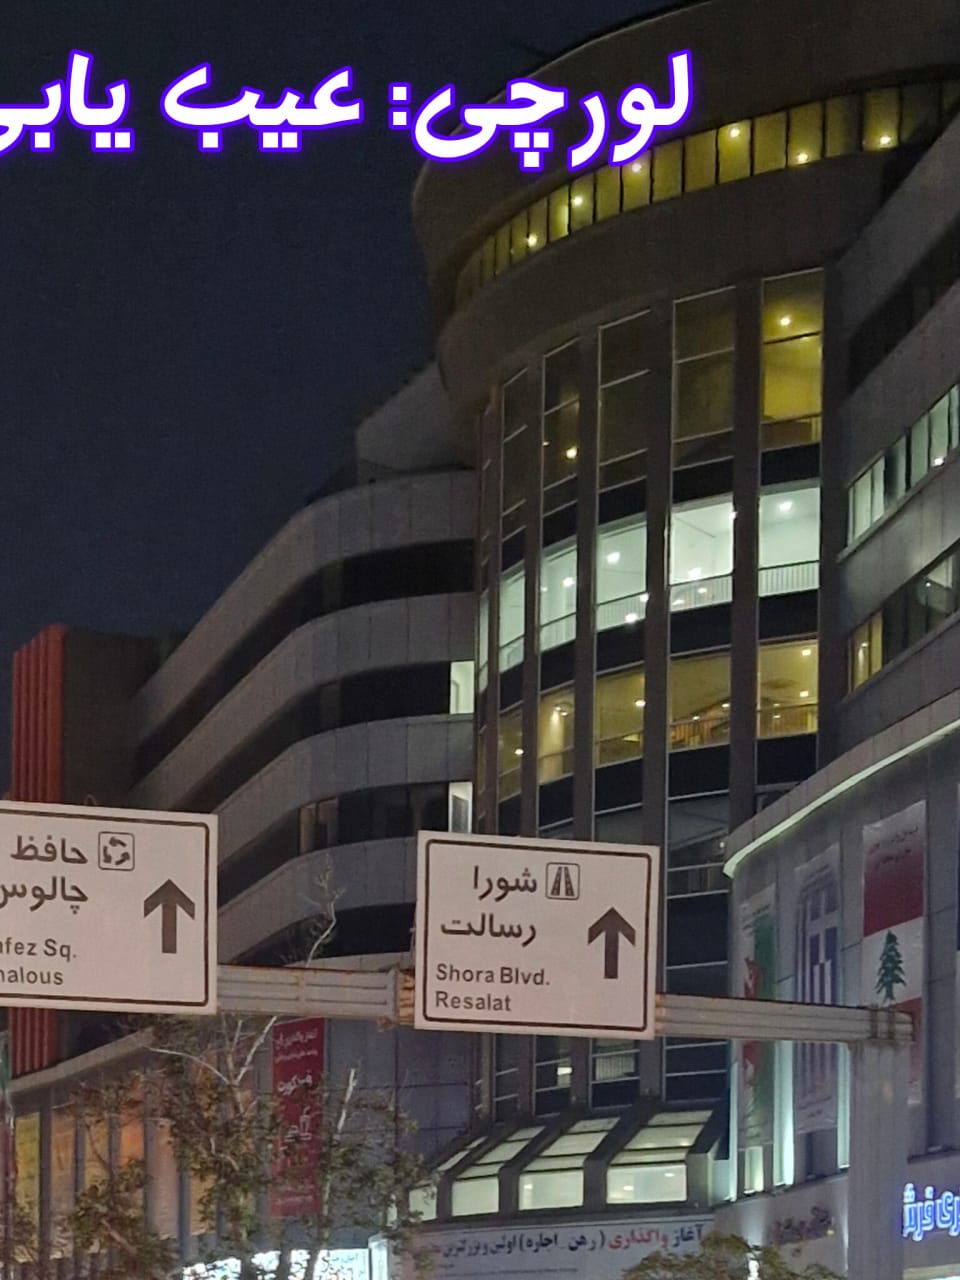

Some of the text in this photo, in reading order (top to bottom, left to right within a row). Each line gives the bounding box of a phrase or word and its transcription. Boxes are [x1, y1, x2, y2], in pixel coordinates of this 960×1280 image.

[10, 834, 89, 865] حافظ
[473, 865, 538, 902] شورا
[440, 913, 537, 947] رسالت
[43, 938, 77, 962] Sq.
[435, 963, 551, 986] Shora Blvd.
[435, 990, 512, 1011] Resalat
[608, 1226, 669, 1250] واگذاری
[672, 1223, 704, 1248] آغاز
